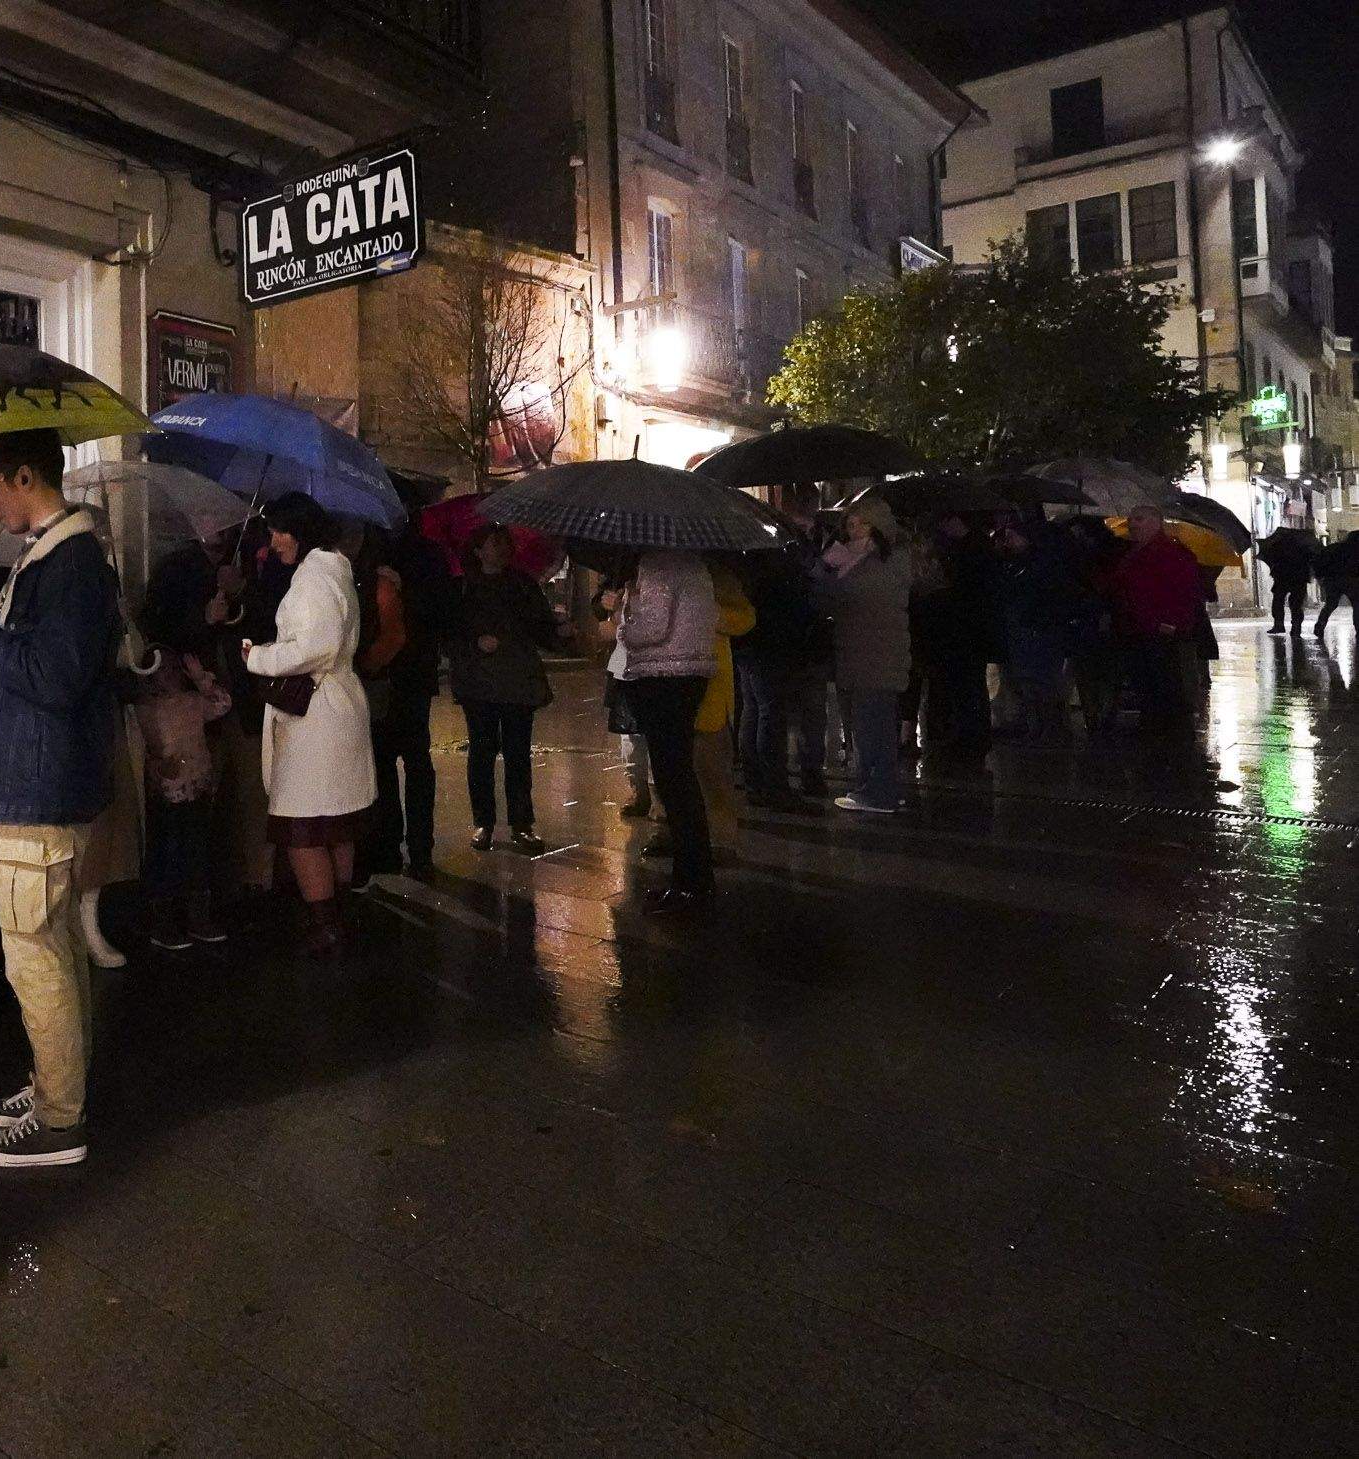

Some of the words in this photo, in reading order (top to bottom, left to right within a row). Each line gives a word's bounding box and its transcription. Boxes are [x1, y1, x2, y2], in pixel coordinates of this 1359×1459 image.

[296, 164, 358, 197] BODEGUIÑA
[248, 206, 293, 264] LA
[306, 166, 410, 245] CATA
[256, 256, 306, 291] RINCÓN
[315, 231, 403, 274] ENCANTADO
[292, 275, 318, 287] PARADA
[318, 264, 362, 280] OBLIGATORIA
[168, 357, 208, 391] VERMÚ
